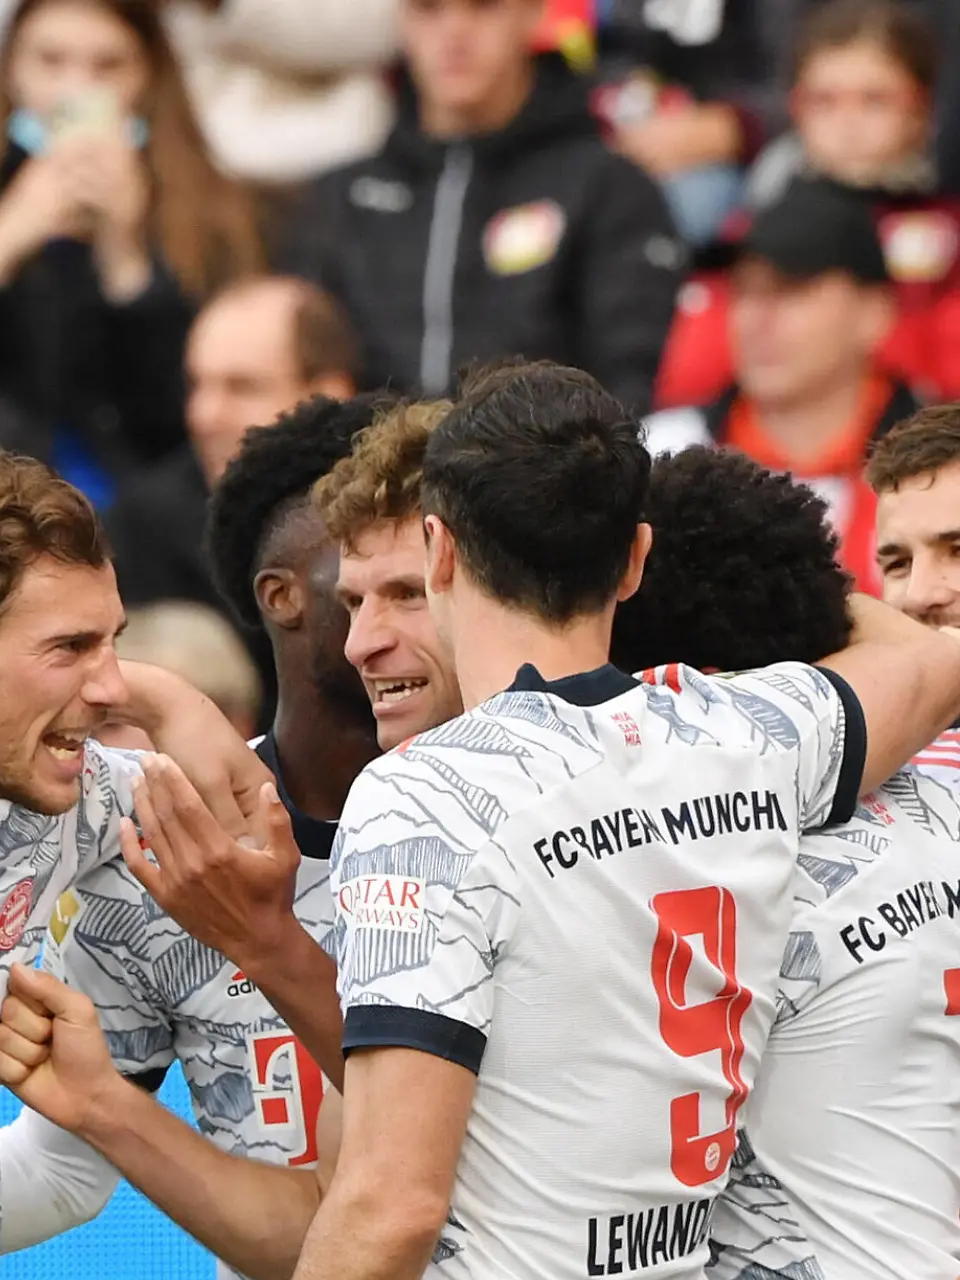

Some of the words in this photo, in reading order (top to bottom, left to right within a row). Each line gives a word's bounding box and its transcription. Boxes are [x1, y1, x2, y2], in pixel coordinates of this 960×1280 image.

[533, 830, 578, 878] FC
[339, 878, 420, 916] QATAR
[839, 916, 886, 964] FC
[649, 885, 752, 1187] 9
[587, 1198, 710, 1277] LEWAND
